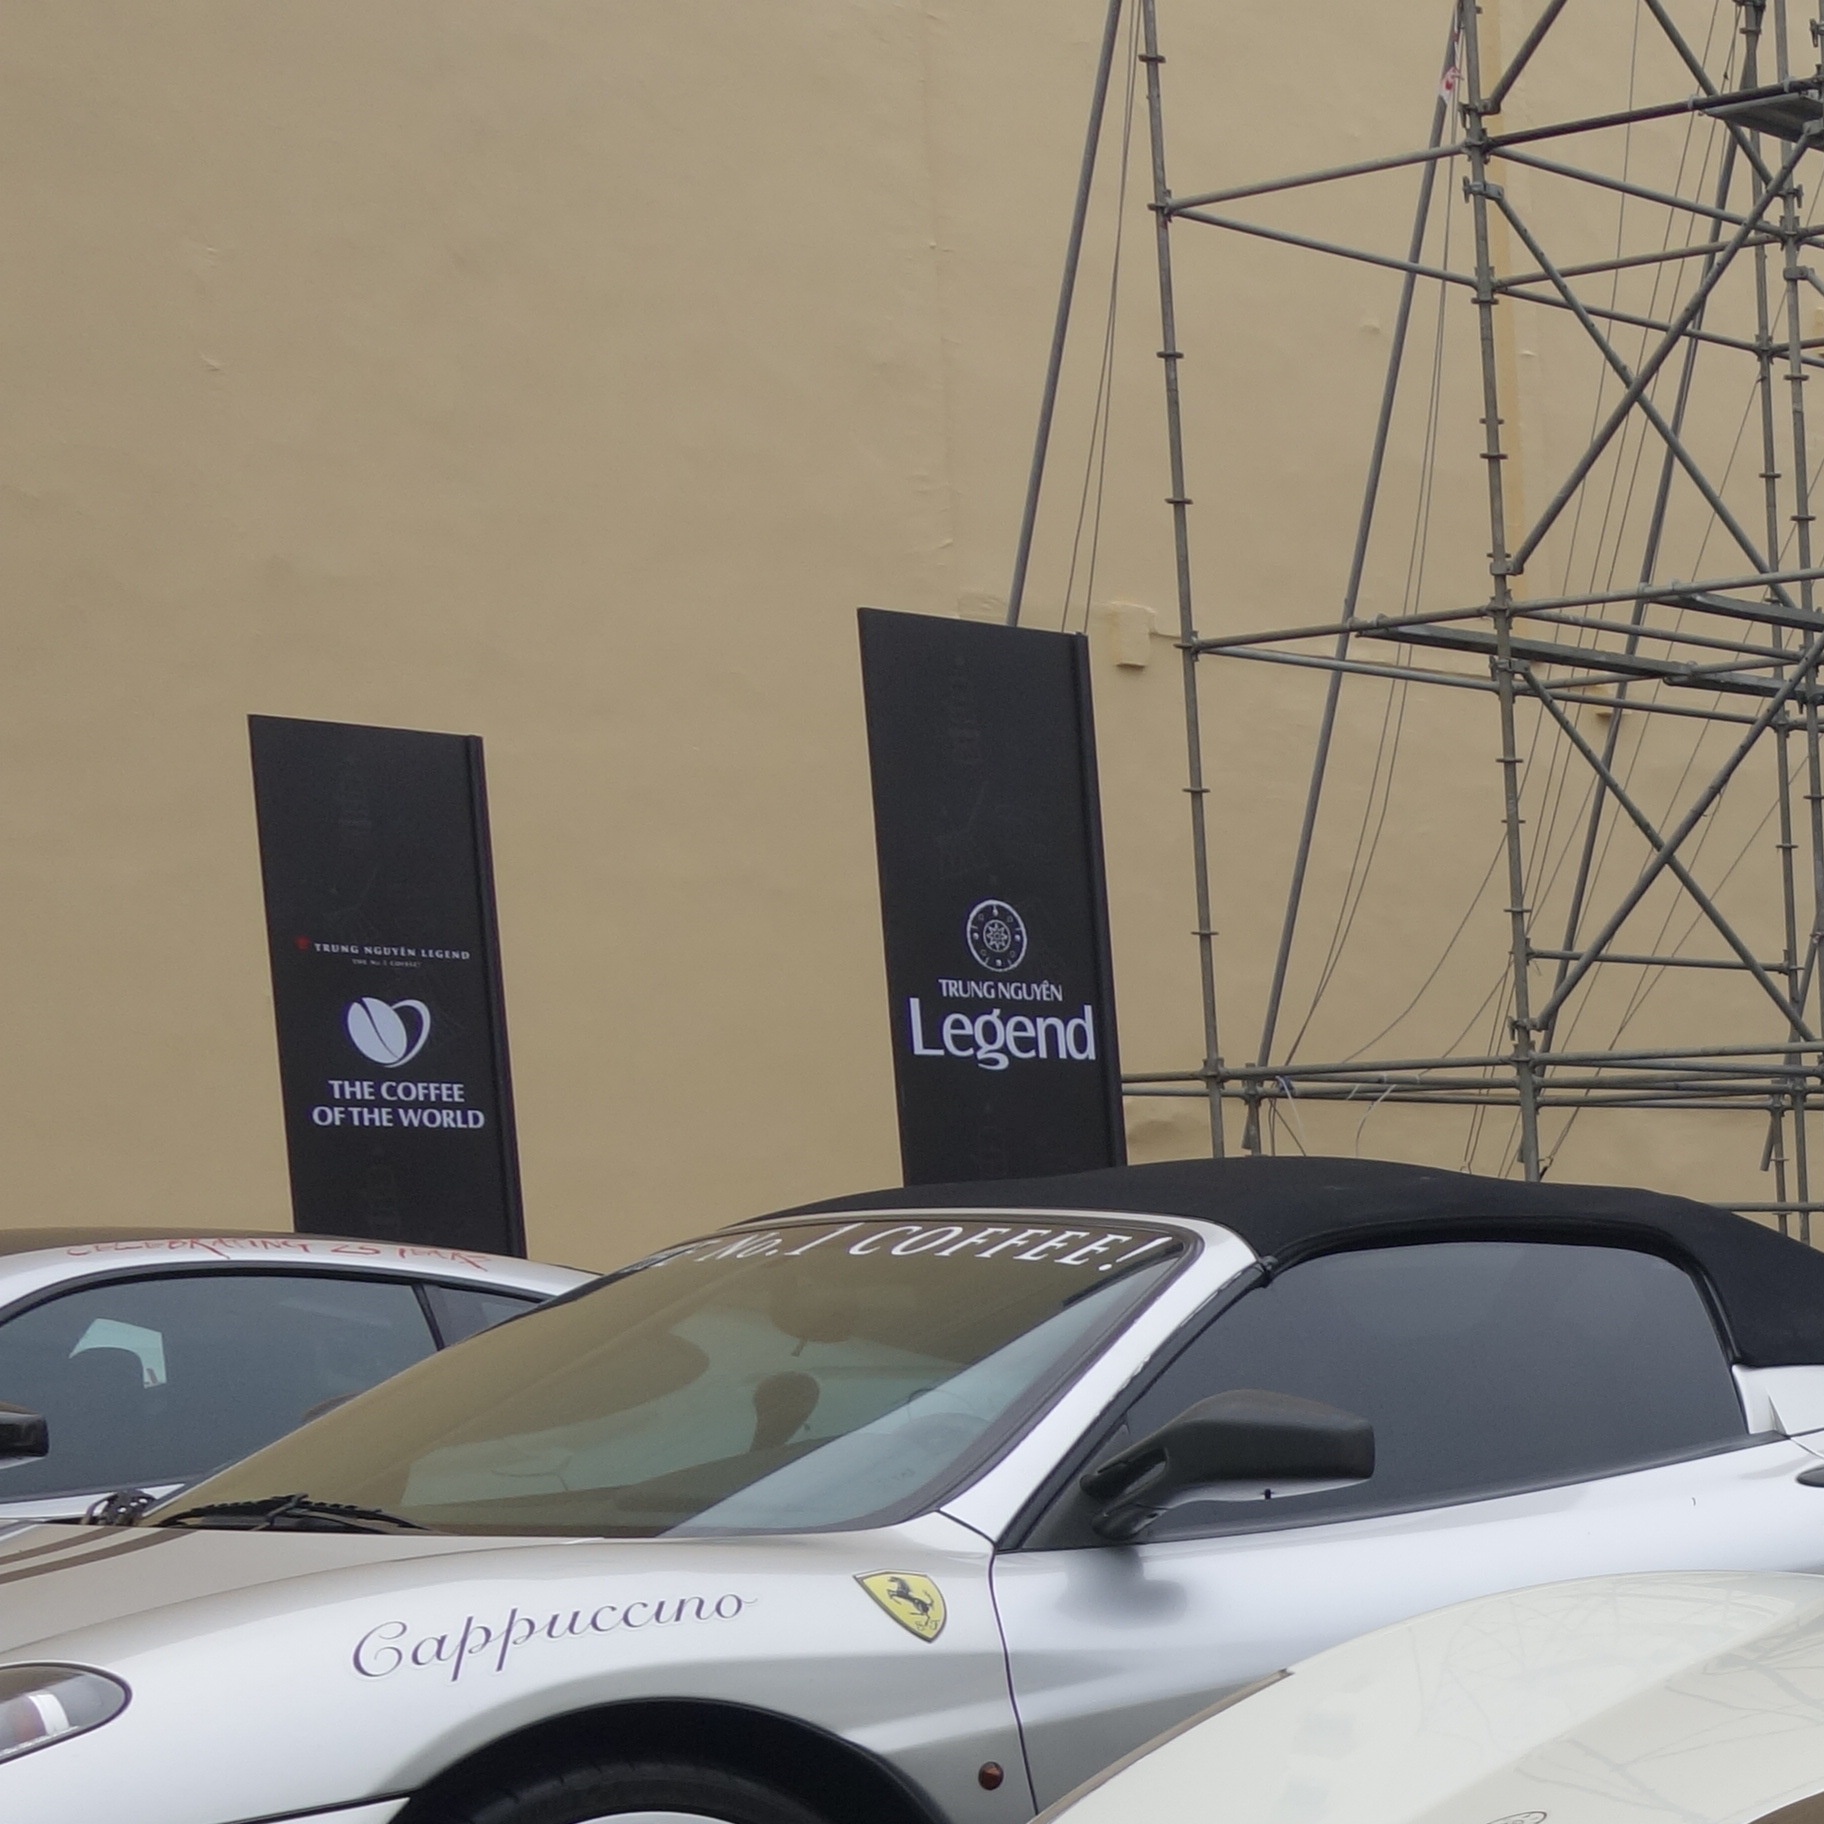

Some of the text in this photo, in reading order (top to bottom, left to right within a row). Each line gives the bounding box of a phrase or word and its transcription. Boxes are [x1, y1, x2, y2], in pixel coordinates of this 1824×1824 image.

[314, 942, 359, 954] TRUNG
[421, 949, 470, 960] LEGEND
[938, 978, 1063, 1001] TRUNG NGUYÊN
[909, 997, 1096, 1070] Legend
[328, 1079, 465, 1102] THE COFFEE
[312, 1106, 485, 1129] OF THE WORLD
[848, 1224, 1172, 1272] COFFEE!
[352, 1593, 758, 1683] Cappuccino
